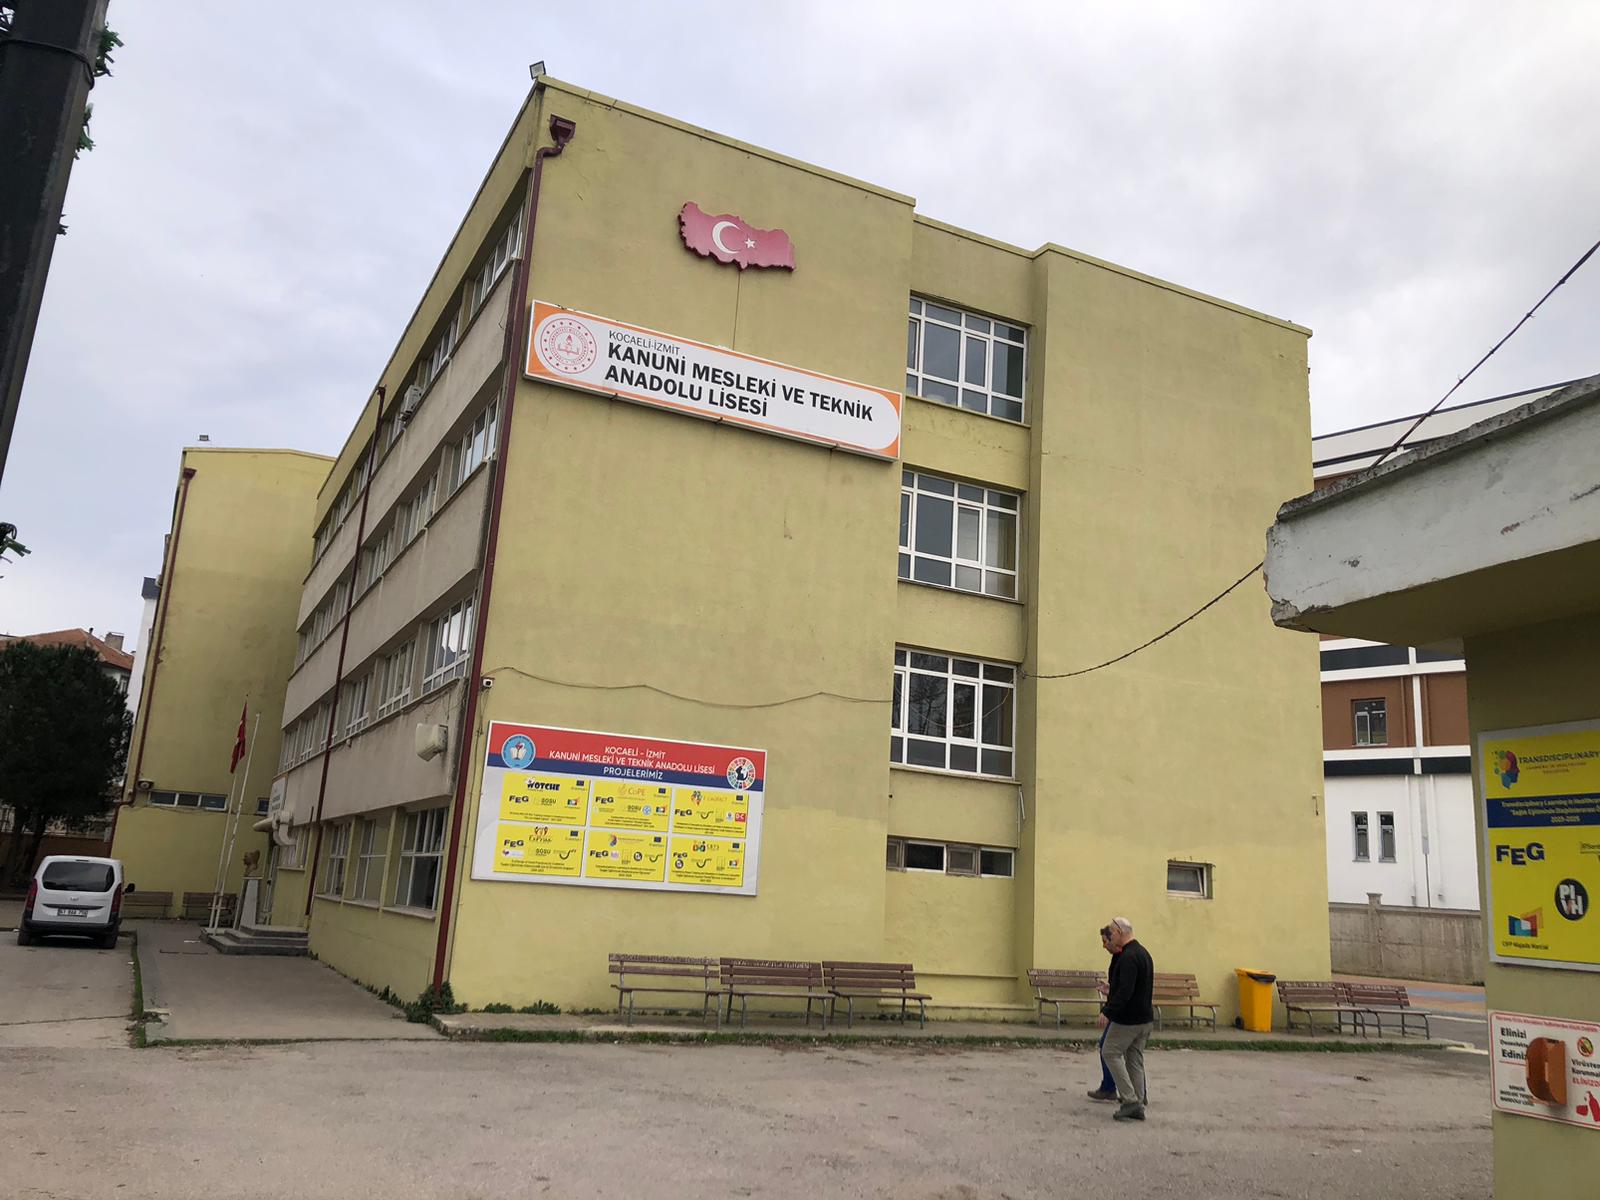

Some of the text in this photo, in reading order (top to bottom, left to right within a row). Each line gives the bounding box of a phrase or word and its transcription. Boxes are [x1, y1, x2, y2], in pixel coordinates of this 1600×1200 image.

[608, 341, 686, 376] KANUNİ
[692, 363, 776, 398] MESLEKİ
[782, 384, 805, 405] VE
[809, 391, 873, 422] TEKNİK
[604, 365, 768, 417] ANADOLU LİSESİ
[605, 746, 639, 757] KOCAELİ
[646, 748, 667, 760] İZMİT
[549, 750, 716, 775] KANUNİ MESLEKİ VE TEKNİK ANADOLU LİSESİ
[603, 766, 664, 780] PROJELERİMİZ
[509, 795, 529, 804] FEG
[595, 796, 614, 804] FEG
[674, 808, 692, 817] FEG
[504, 839, 524, 848] FEG
[590, 850, 609, 858] FEG
[1496, 842, 1545, 865] FEG
[1501, 1027, 1527, 1039] Elinizi
